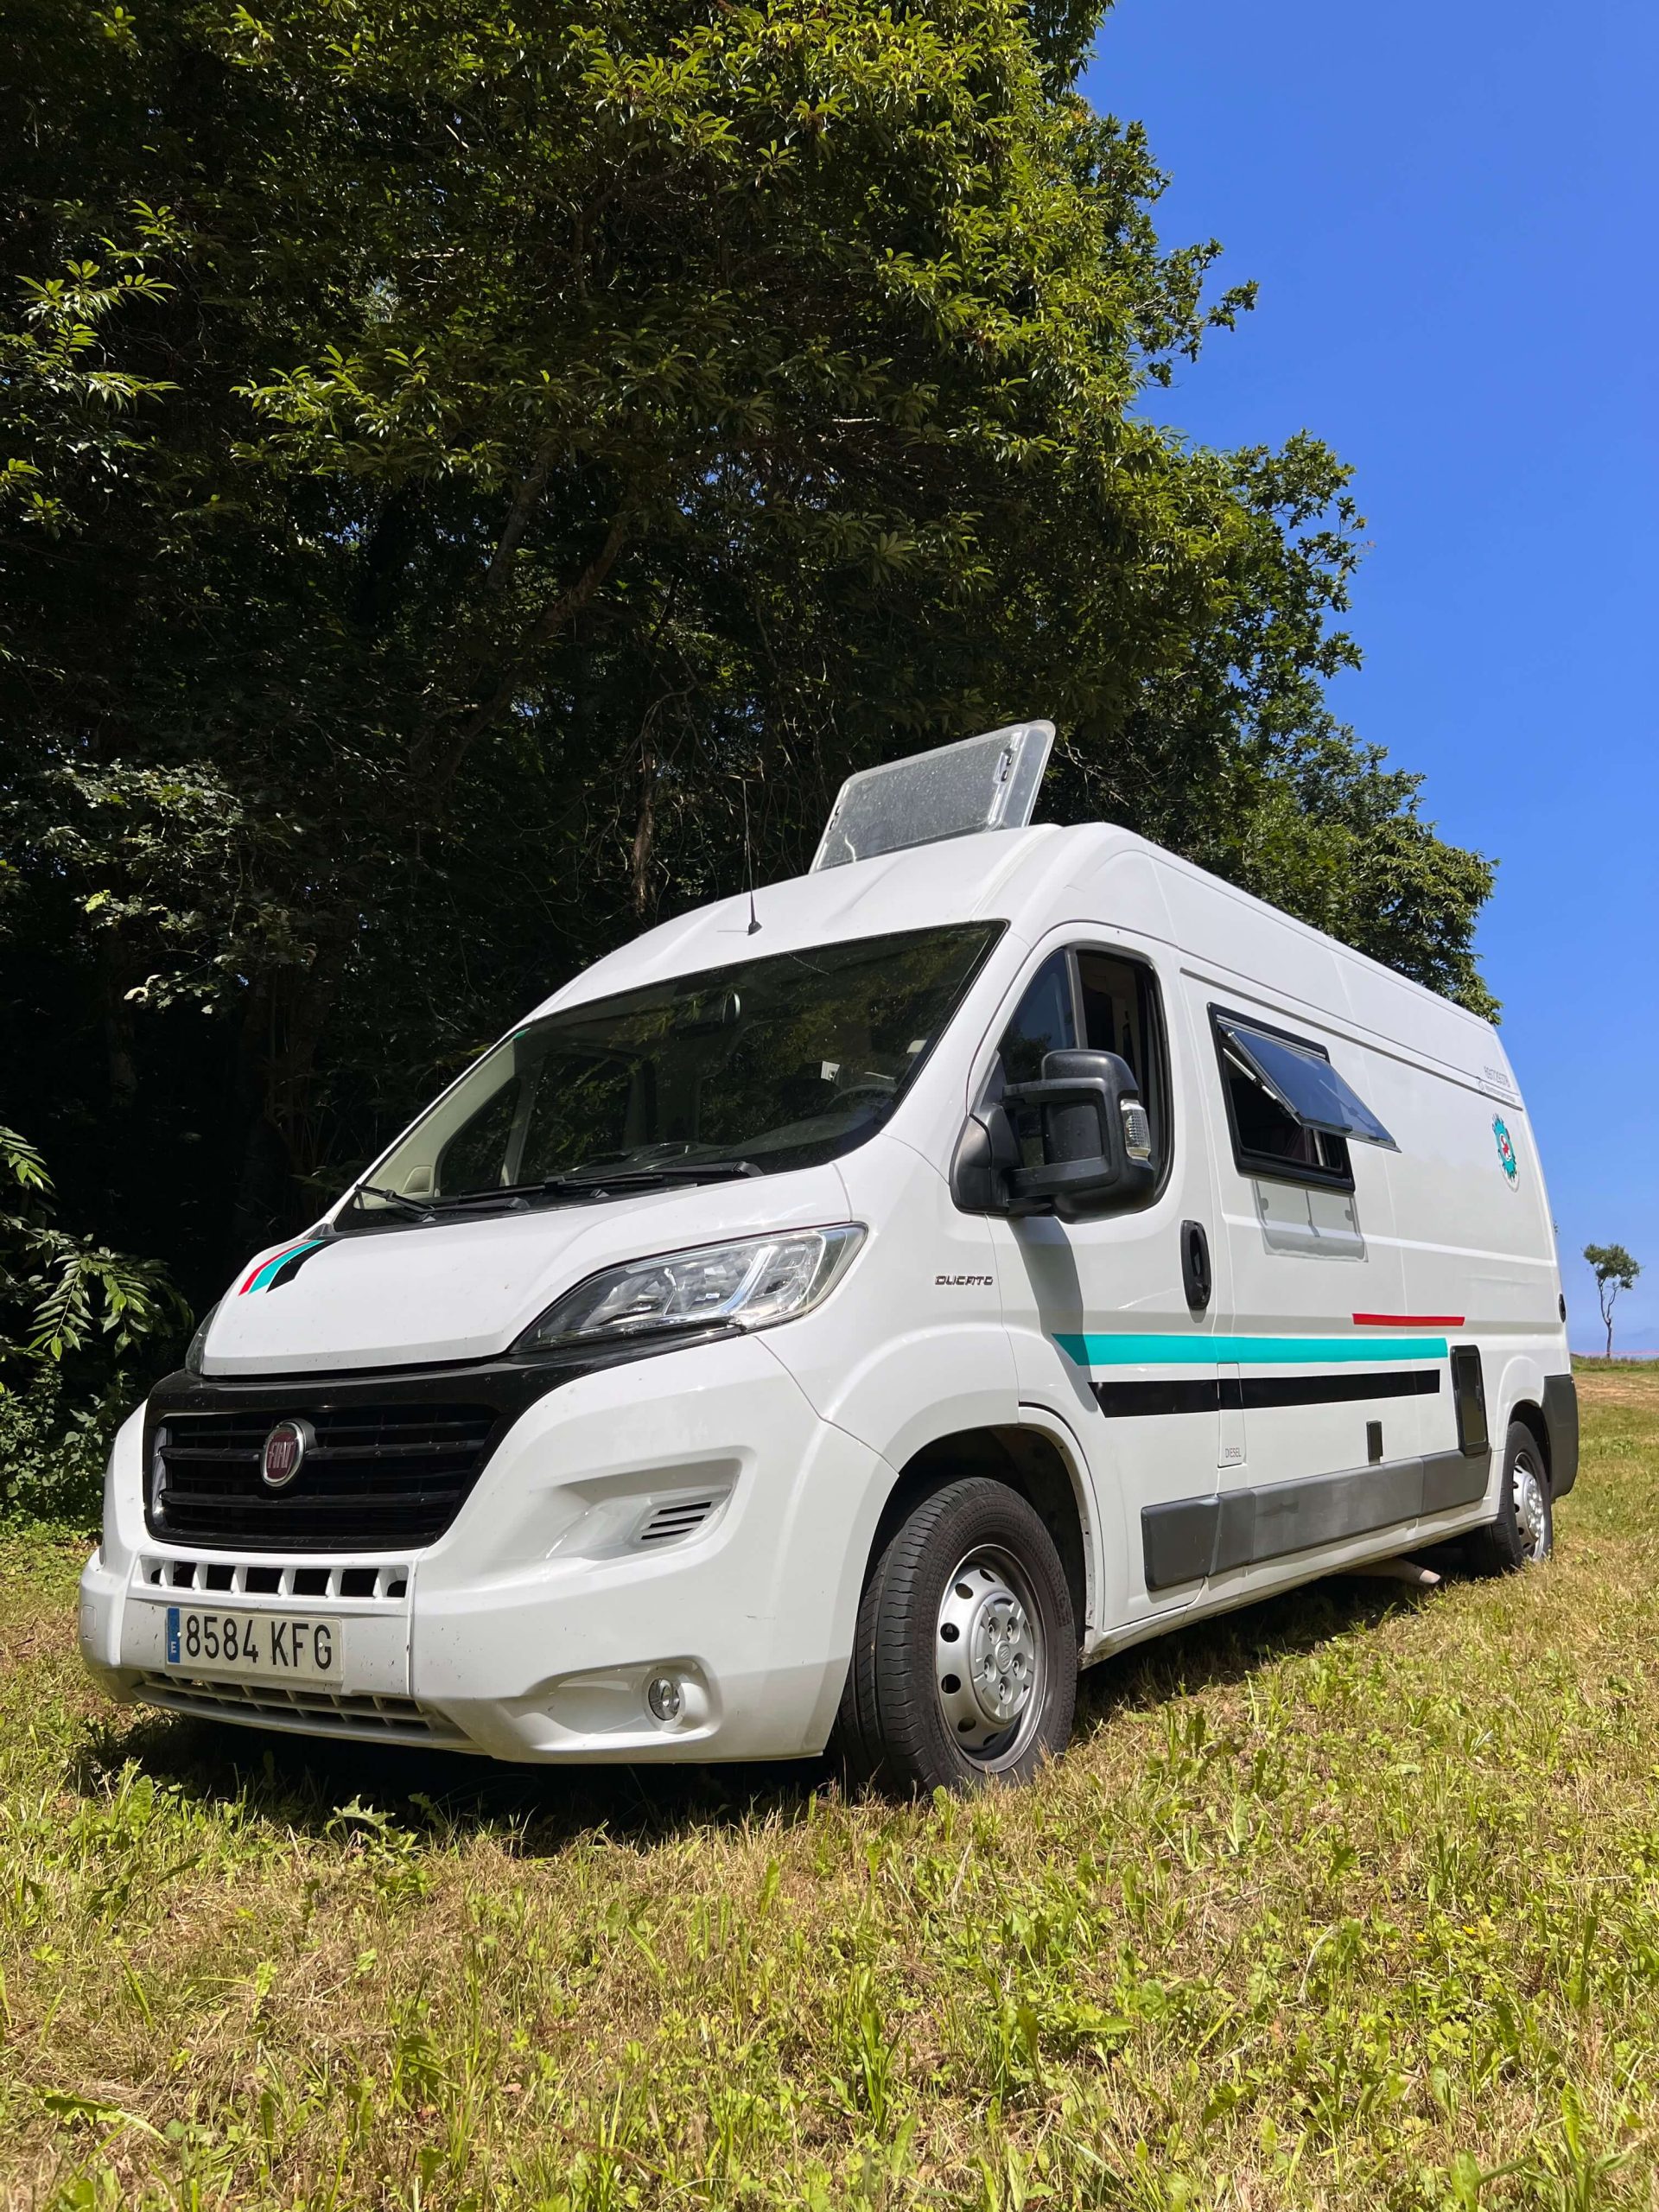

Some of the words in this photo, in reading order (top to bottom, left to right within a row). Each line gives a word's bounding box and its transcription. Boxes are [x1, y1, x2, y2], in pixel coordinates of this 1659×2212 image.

[935, 1275, 994, 1286] DUCATO
[267, 1440, 294, 1469] FIAT
[1224, 1447, 1242, 1459] DIESEL
[170, 1641, 177, 1654] E
[186, 1614, 259, 1663] 8584
[270, 1620, 332, 1670] KFG
